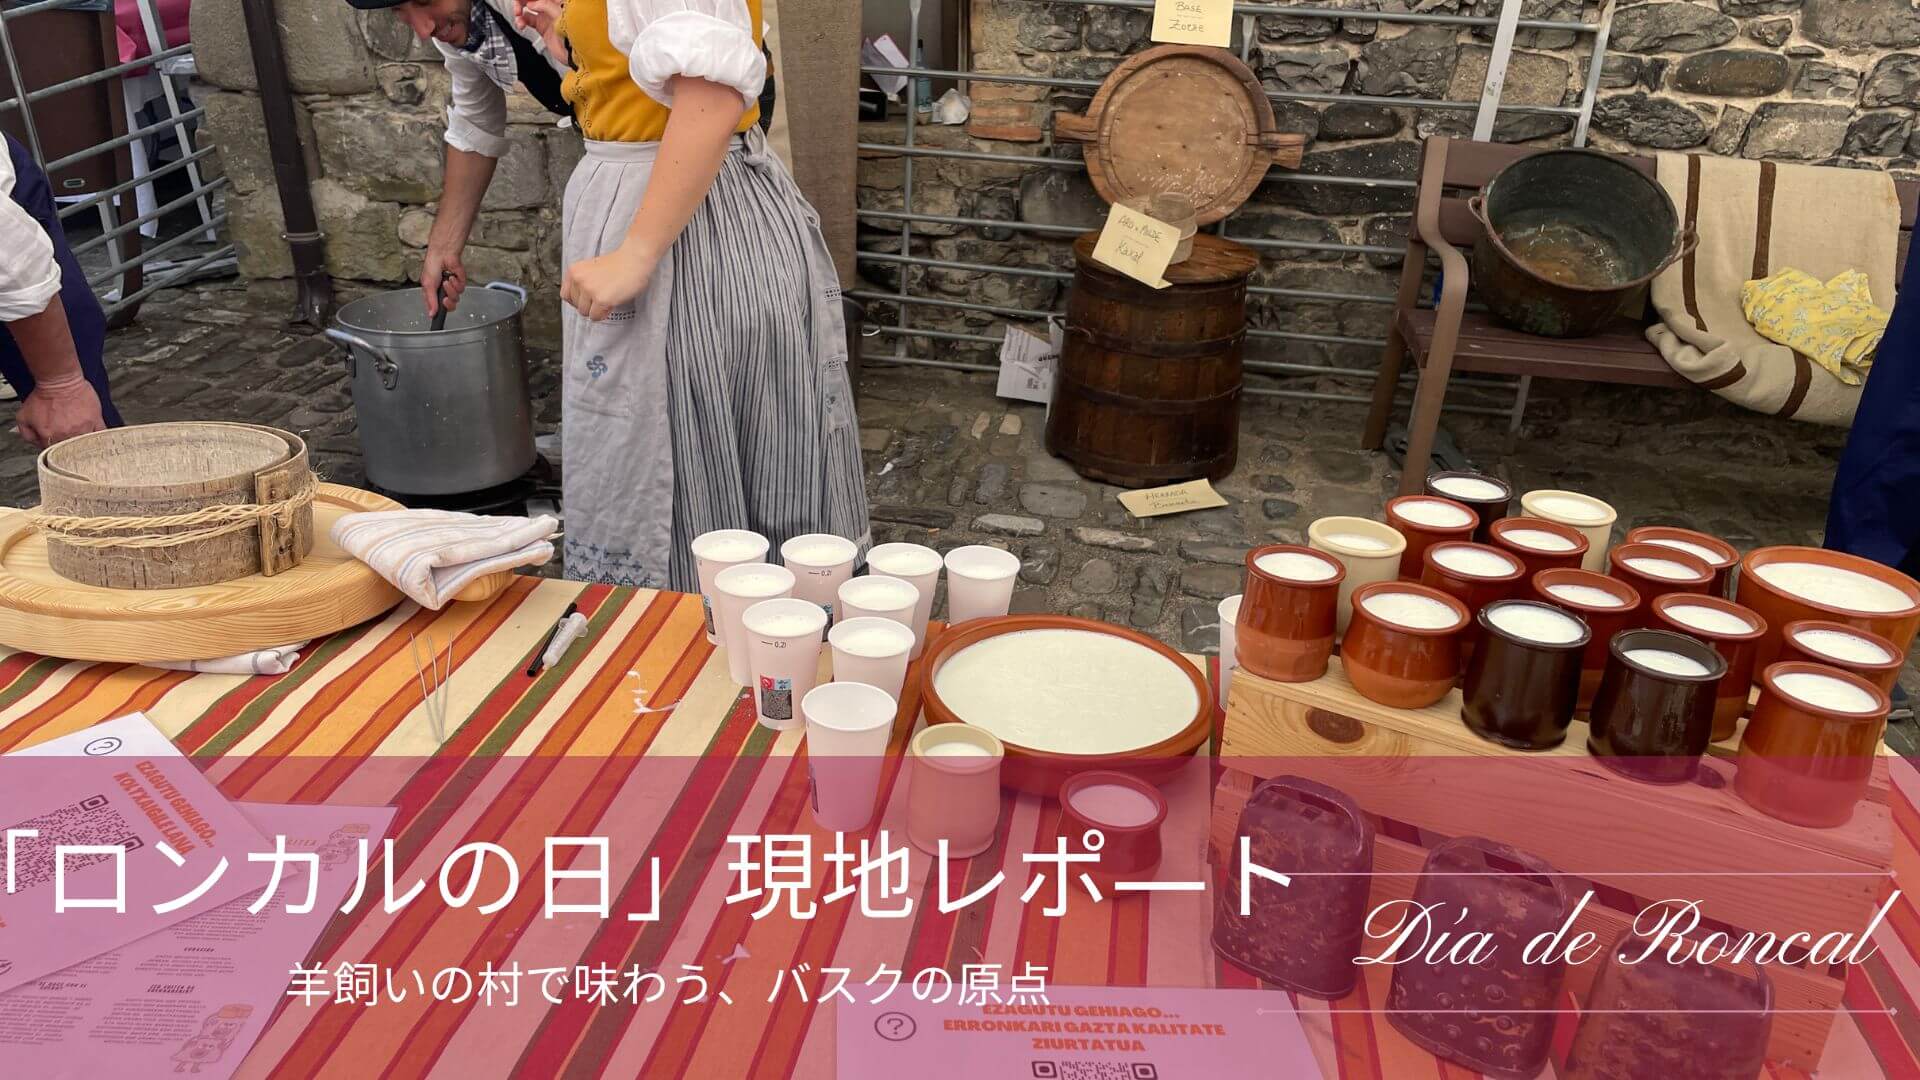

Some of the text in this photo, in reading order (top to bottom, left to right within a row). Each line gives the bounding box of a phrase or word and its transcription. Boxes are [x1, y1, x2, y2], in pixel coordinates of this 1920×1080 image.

[982, 1003, 1071, 1017] EZAGUTU
[943, 1019, 1227, 1036] ERRONKARI GAZTA KALITATE
[1031, 1037, 1147, 1052] ZIURTATUA
